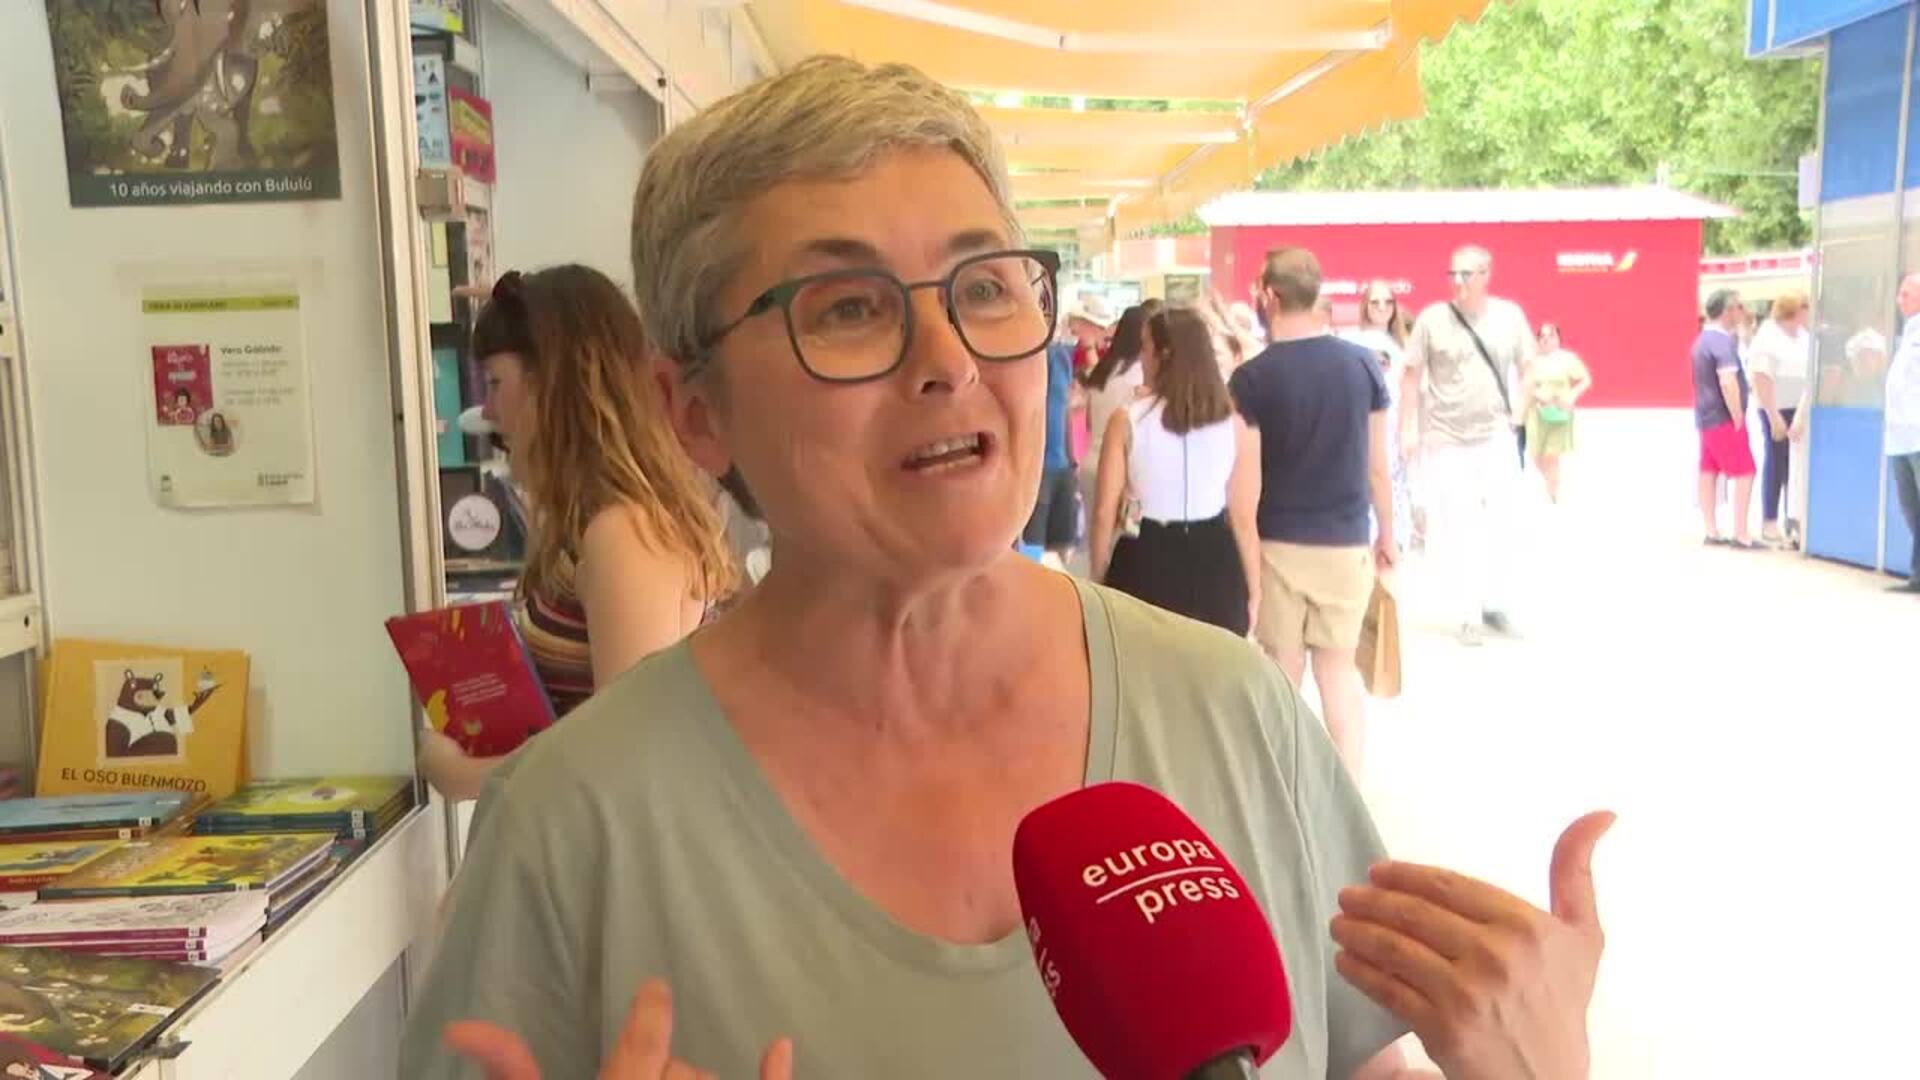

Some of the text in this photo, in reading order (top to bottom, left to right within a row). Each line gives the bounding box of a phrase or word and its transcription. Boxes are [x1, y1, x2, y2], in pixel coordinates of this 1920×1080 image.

[110, 182, 129, 197] 10
[132, 181, 167, 197] años
[169, 179, 232, 198] viajando
[235, 181, 262, 194] con
[61, 767, 207, 793] EL OSO BUENMOZO
[1081, 838, 1217, 887] europa
[1134, 876, 1240, 924] press
